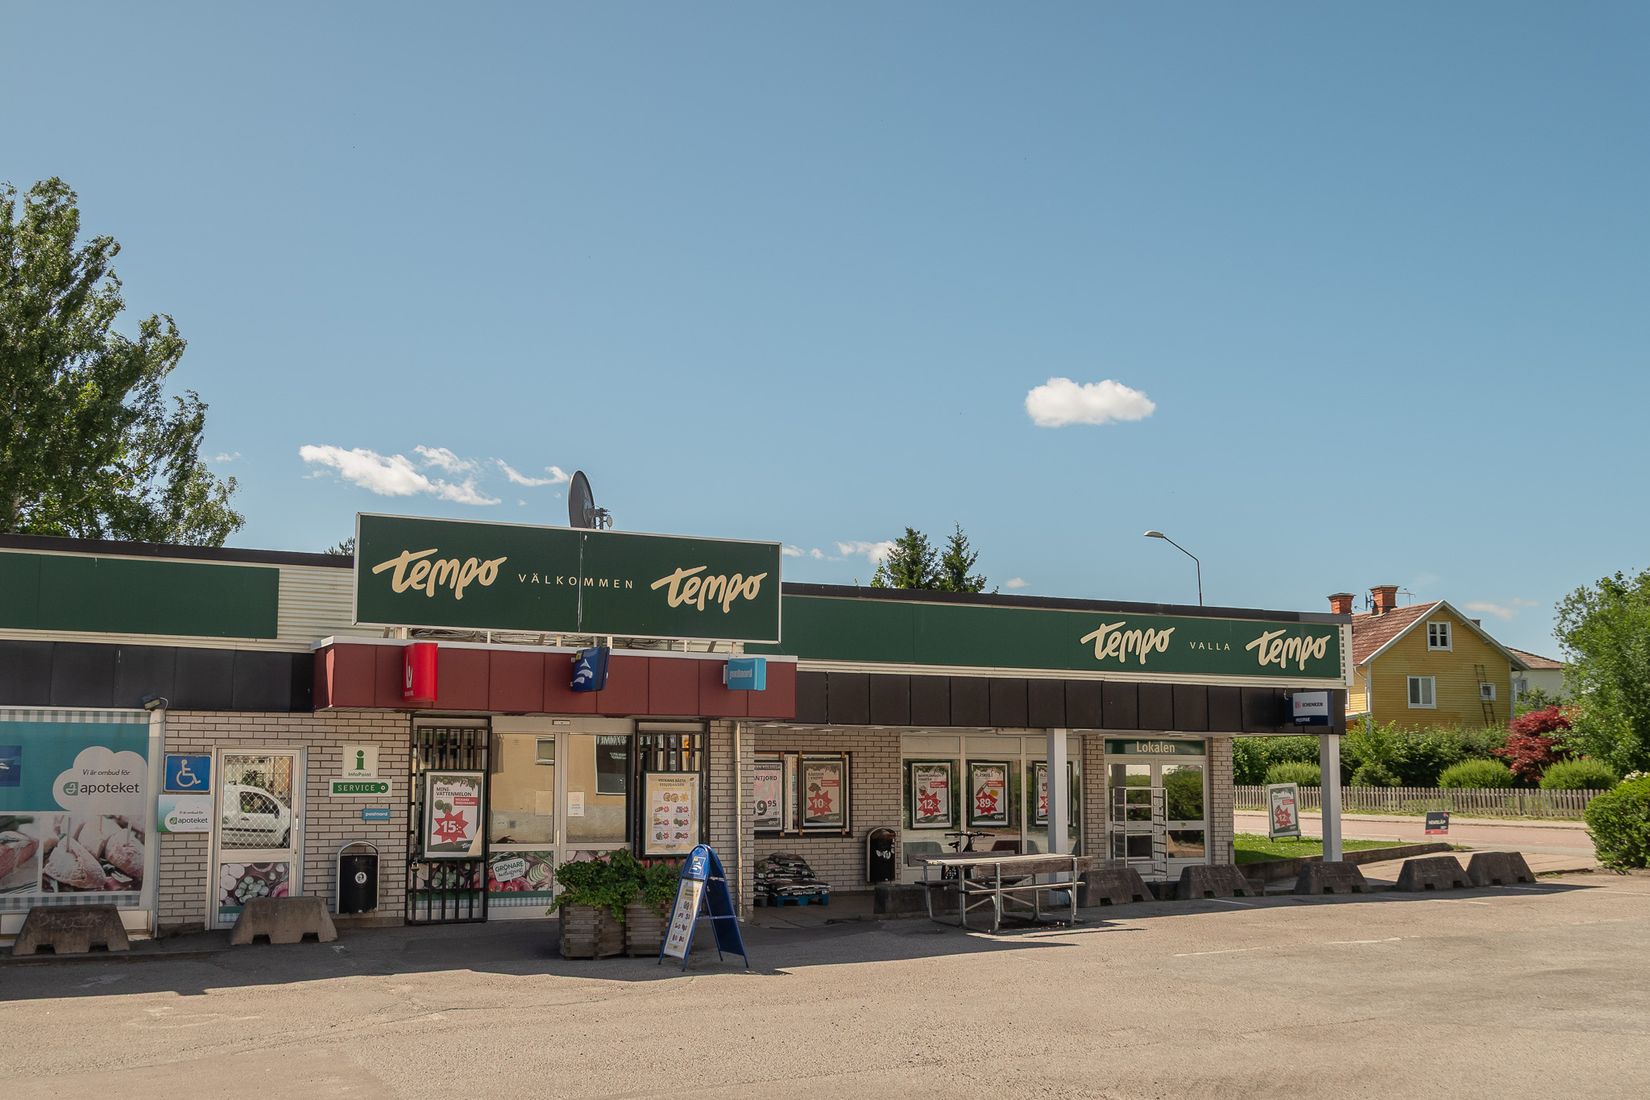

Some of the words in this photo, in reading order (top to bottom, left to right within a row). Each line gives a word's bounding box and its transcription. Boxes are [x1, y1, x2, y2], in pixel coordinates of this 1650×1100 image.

[372, 548, 507, 600] tempo
[518, 573, 633, 588] VÄLKOMMEN
[650, 565, 768, 613] tempo
[1080, 621, 1175, 664] tempo
[1189, 641, 1231, 651] VALLA
[1245, 629, 1332, 671] tempo
[1136, 741, 1175, 753] Lokalen
[80, 782, 140, 796] apoteket
[337, 784, 376, 792] SERVICE
